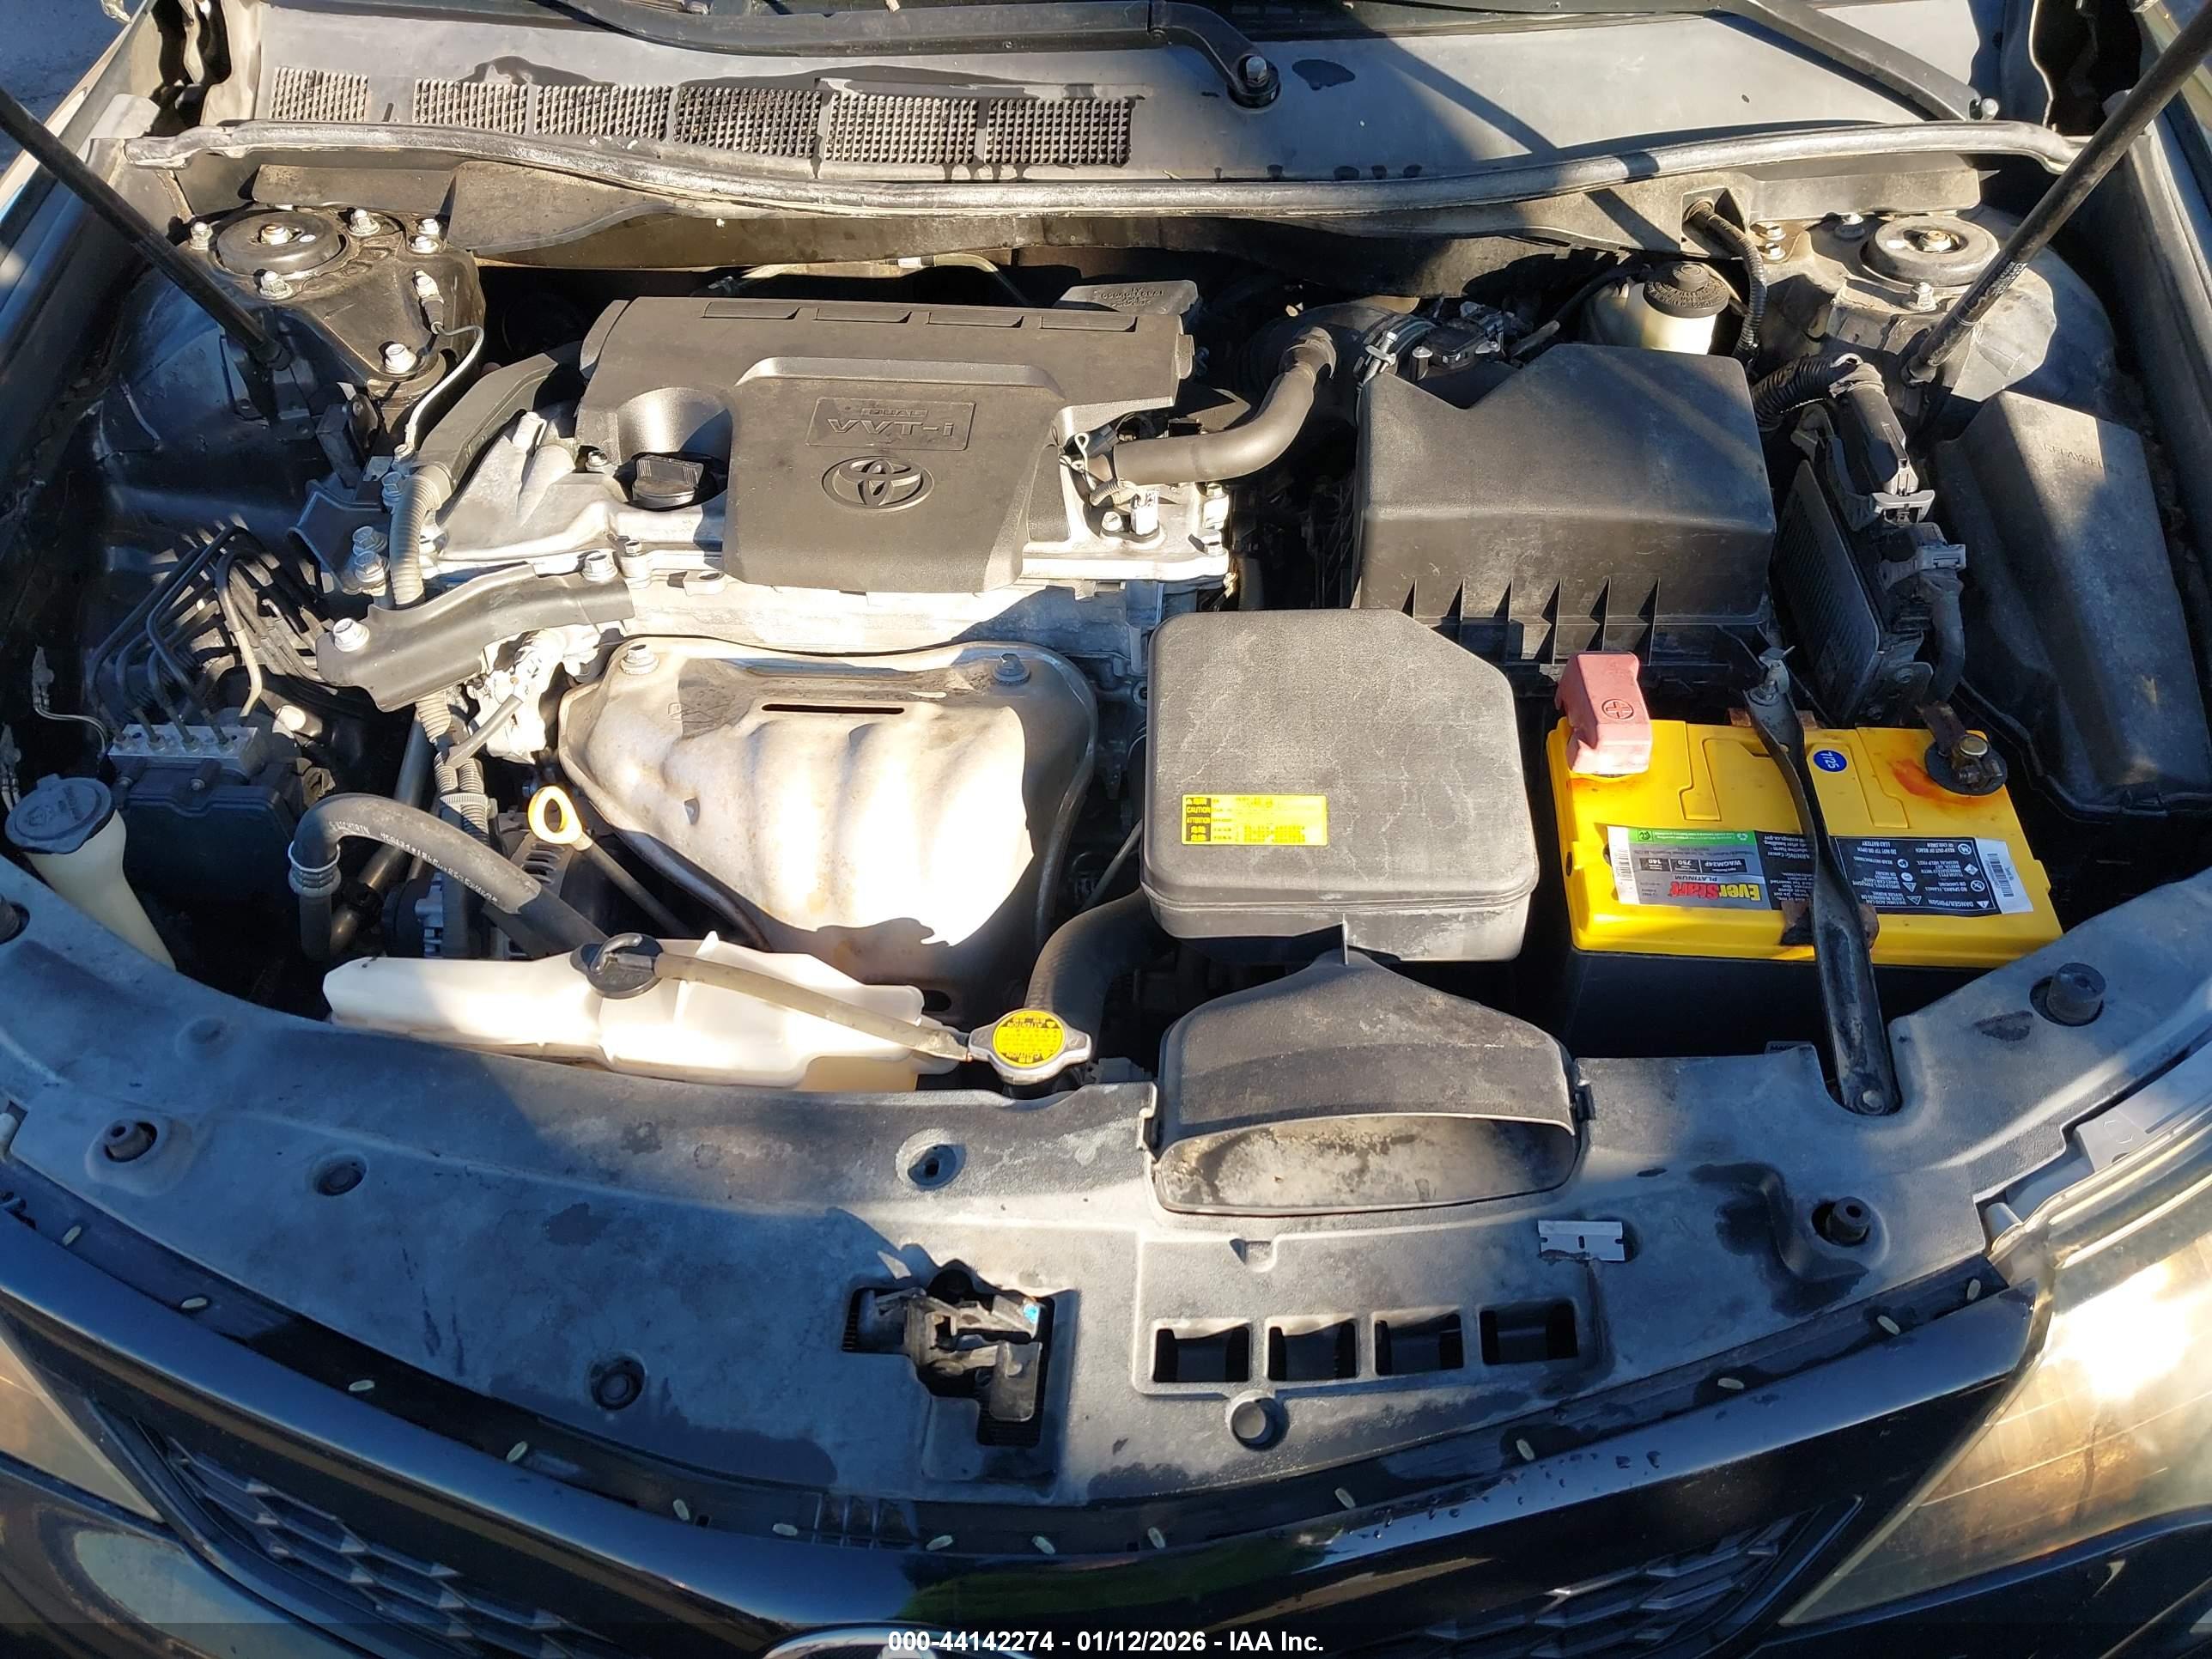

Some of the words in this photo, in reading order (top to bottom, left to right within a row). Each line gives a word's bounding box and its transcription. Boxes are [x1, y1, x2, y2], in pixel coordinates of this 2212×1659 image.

[827, 418, 954, 436] VVT-i
[1820, 751, 1840, 769] 7/25
[1669, 881, 1762, 902] EverStart
